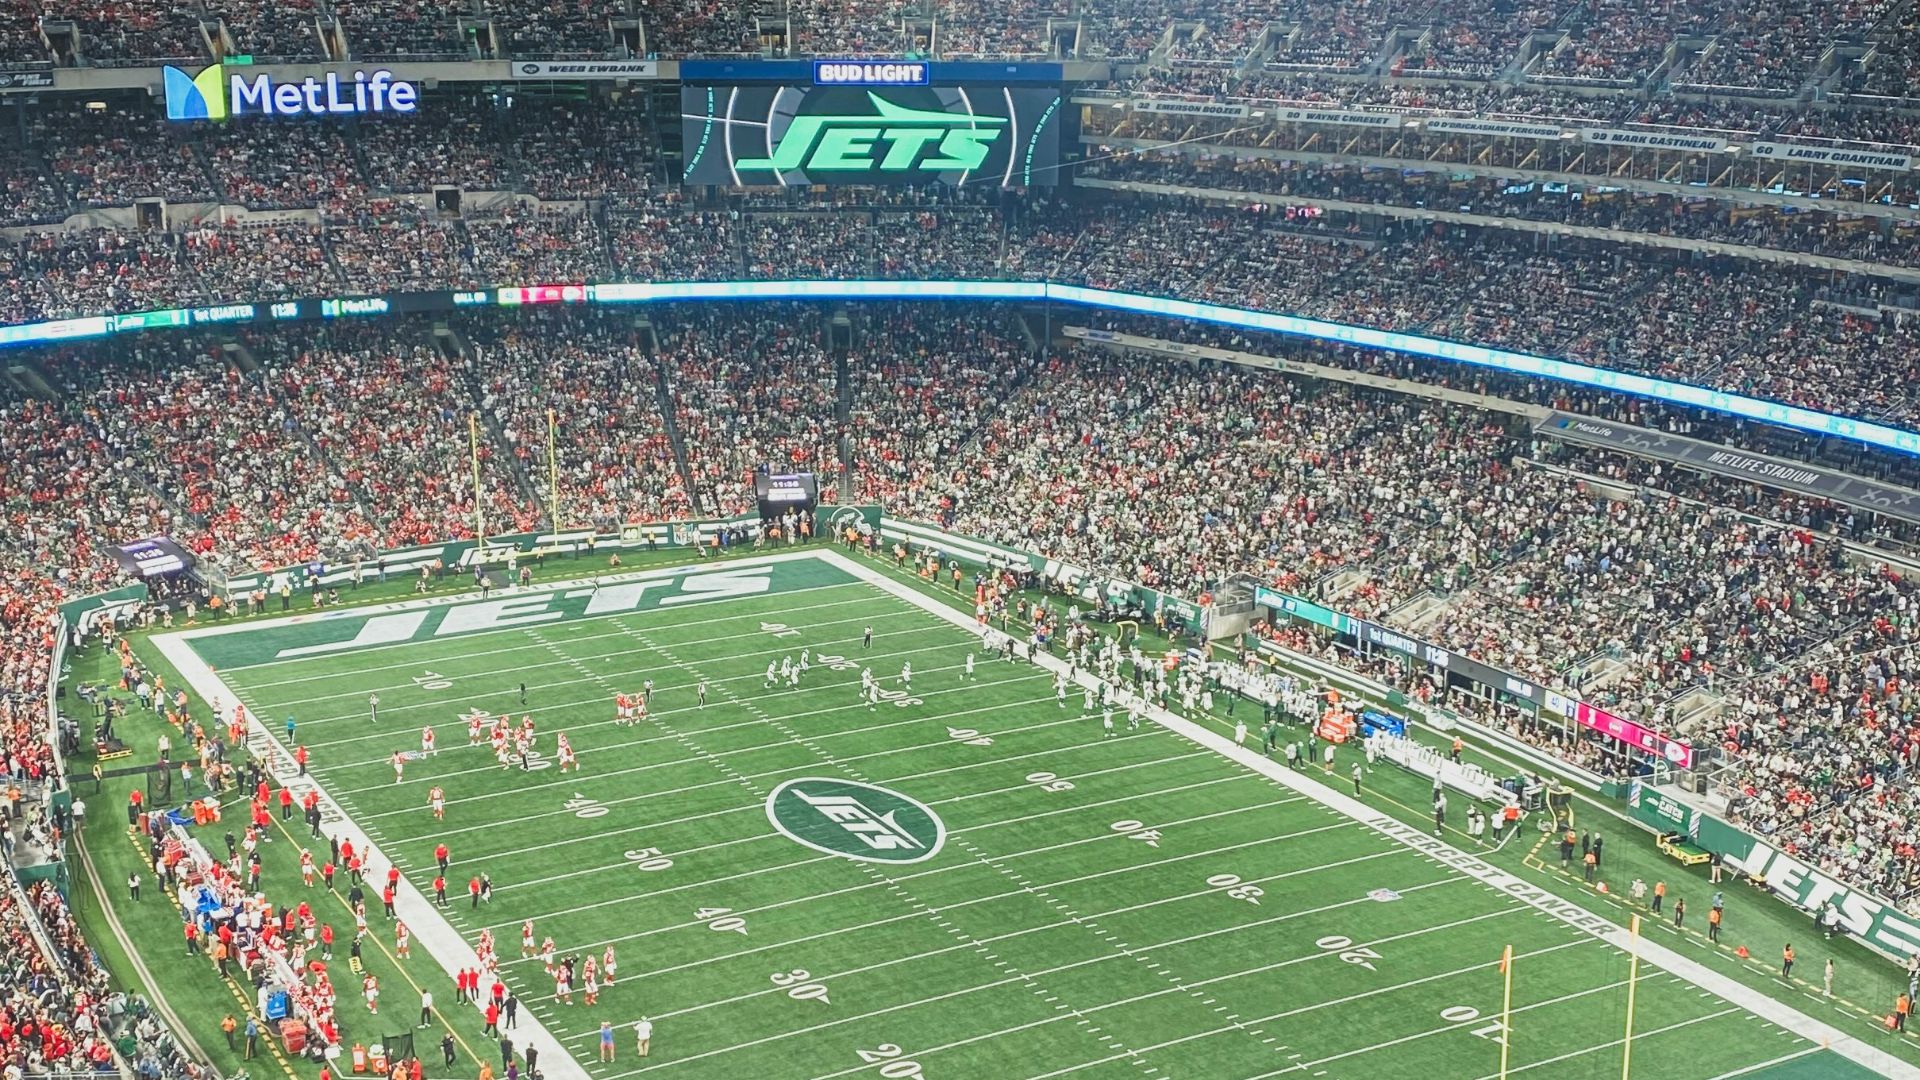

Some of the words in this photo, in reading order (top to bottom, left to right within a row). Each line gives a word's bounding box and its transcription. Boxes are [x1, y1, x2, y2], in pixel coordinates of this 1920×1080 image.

[549, 65, 587, 73] WEEB
[588, 64, 647, 73] EWBANK
[820, 64, 863, 82] BUD
[864, 64, 924, 81] LIGHT
[231, 70, 417, 114] MetLife
[1155, 103, 1201, 114] EMERSON
[1202, 106, 1242, 116] BOOZER
[1306, 112, 1341, 122] WAYNE
[735, 90, 1008, 170] JETS
[1509, 126, 1560, 137] FERGUSON
[1611, 133, 1648, 145] MARK
[1648, 137, 1717, 150] GASTINEAU
[1755, 145, 1773, 156] 60
[1786, 148, 1830, 160] LARRY
[1830, 153, 1906, 167] GRANTHAM
[209, 305, 254, 321] QUARTER
[341, 298, 388, 314] MetLife
[1575, 421, 1613, 437] MetLife
[1706, 450, 1762, 475] METLIFE
[1758, 460, 1820, 487] STADIUM
[275, 565, 774, 658] JETS
[1381, 631, 1418, 655] QUARTER
[412, 671, 453, 690] 10
[1025, 771, 1076, 792] 50
[563, 798, 610, 818] 40
[790, 788, 927, 850] JETS
[1110, 819, 1163, 842] 40
[623, 846, 674, 871] 50
[1206, 873, 1265, 900] 30
[1367, 816, 1505, 879] INTERCEPT
[1503, 881, 1619, 937] CANCER
[1722, 841, 1883, 937] JETS
[693, 907, 747, 932] 40
[1315, 935, 1384, 965] 20
[770, 968, 829, 1000] 30
[1440, 1005, 1515, 1040] 10
[855, 1043, 923, 1079] 20
